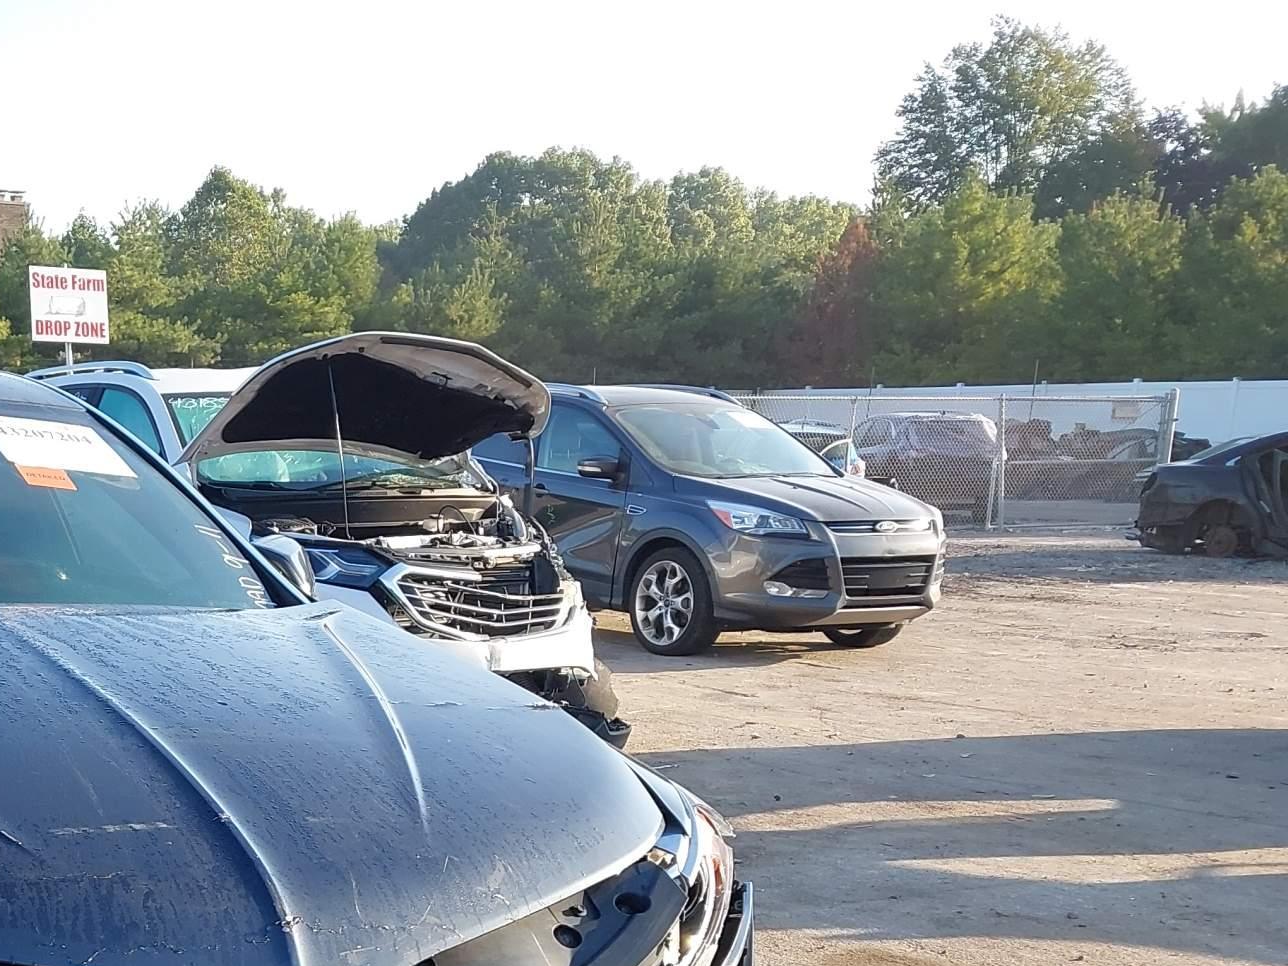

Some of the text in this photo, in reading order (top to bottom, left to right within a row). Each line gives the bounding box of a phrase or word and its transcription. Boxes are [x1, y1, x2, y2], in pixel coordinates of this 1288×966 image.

[32, 272, 105, 292] State Farm
[35, 319, 106, 338] DROP ZONE
